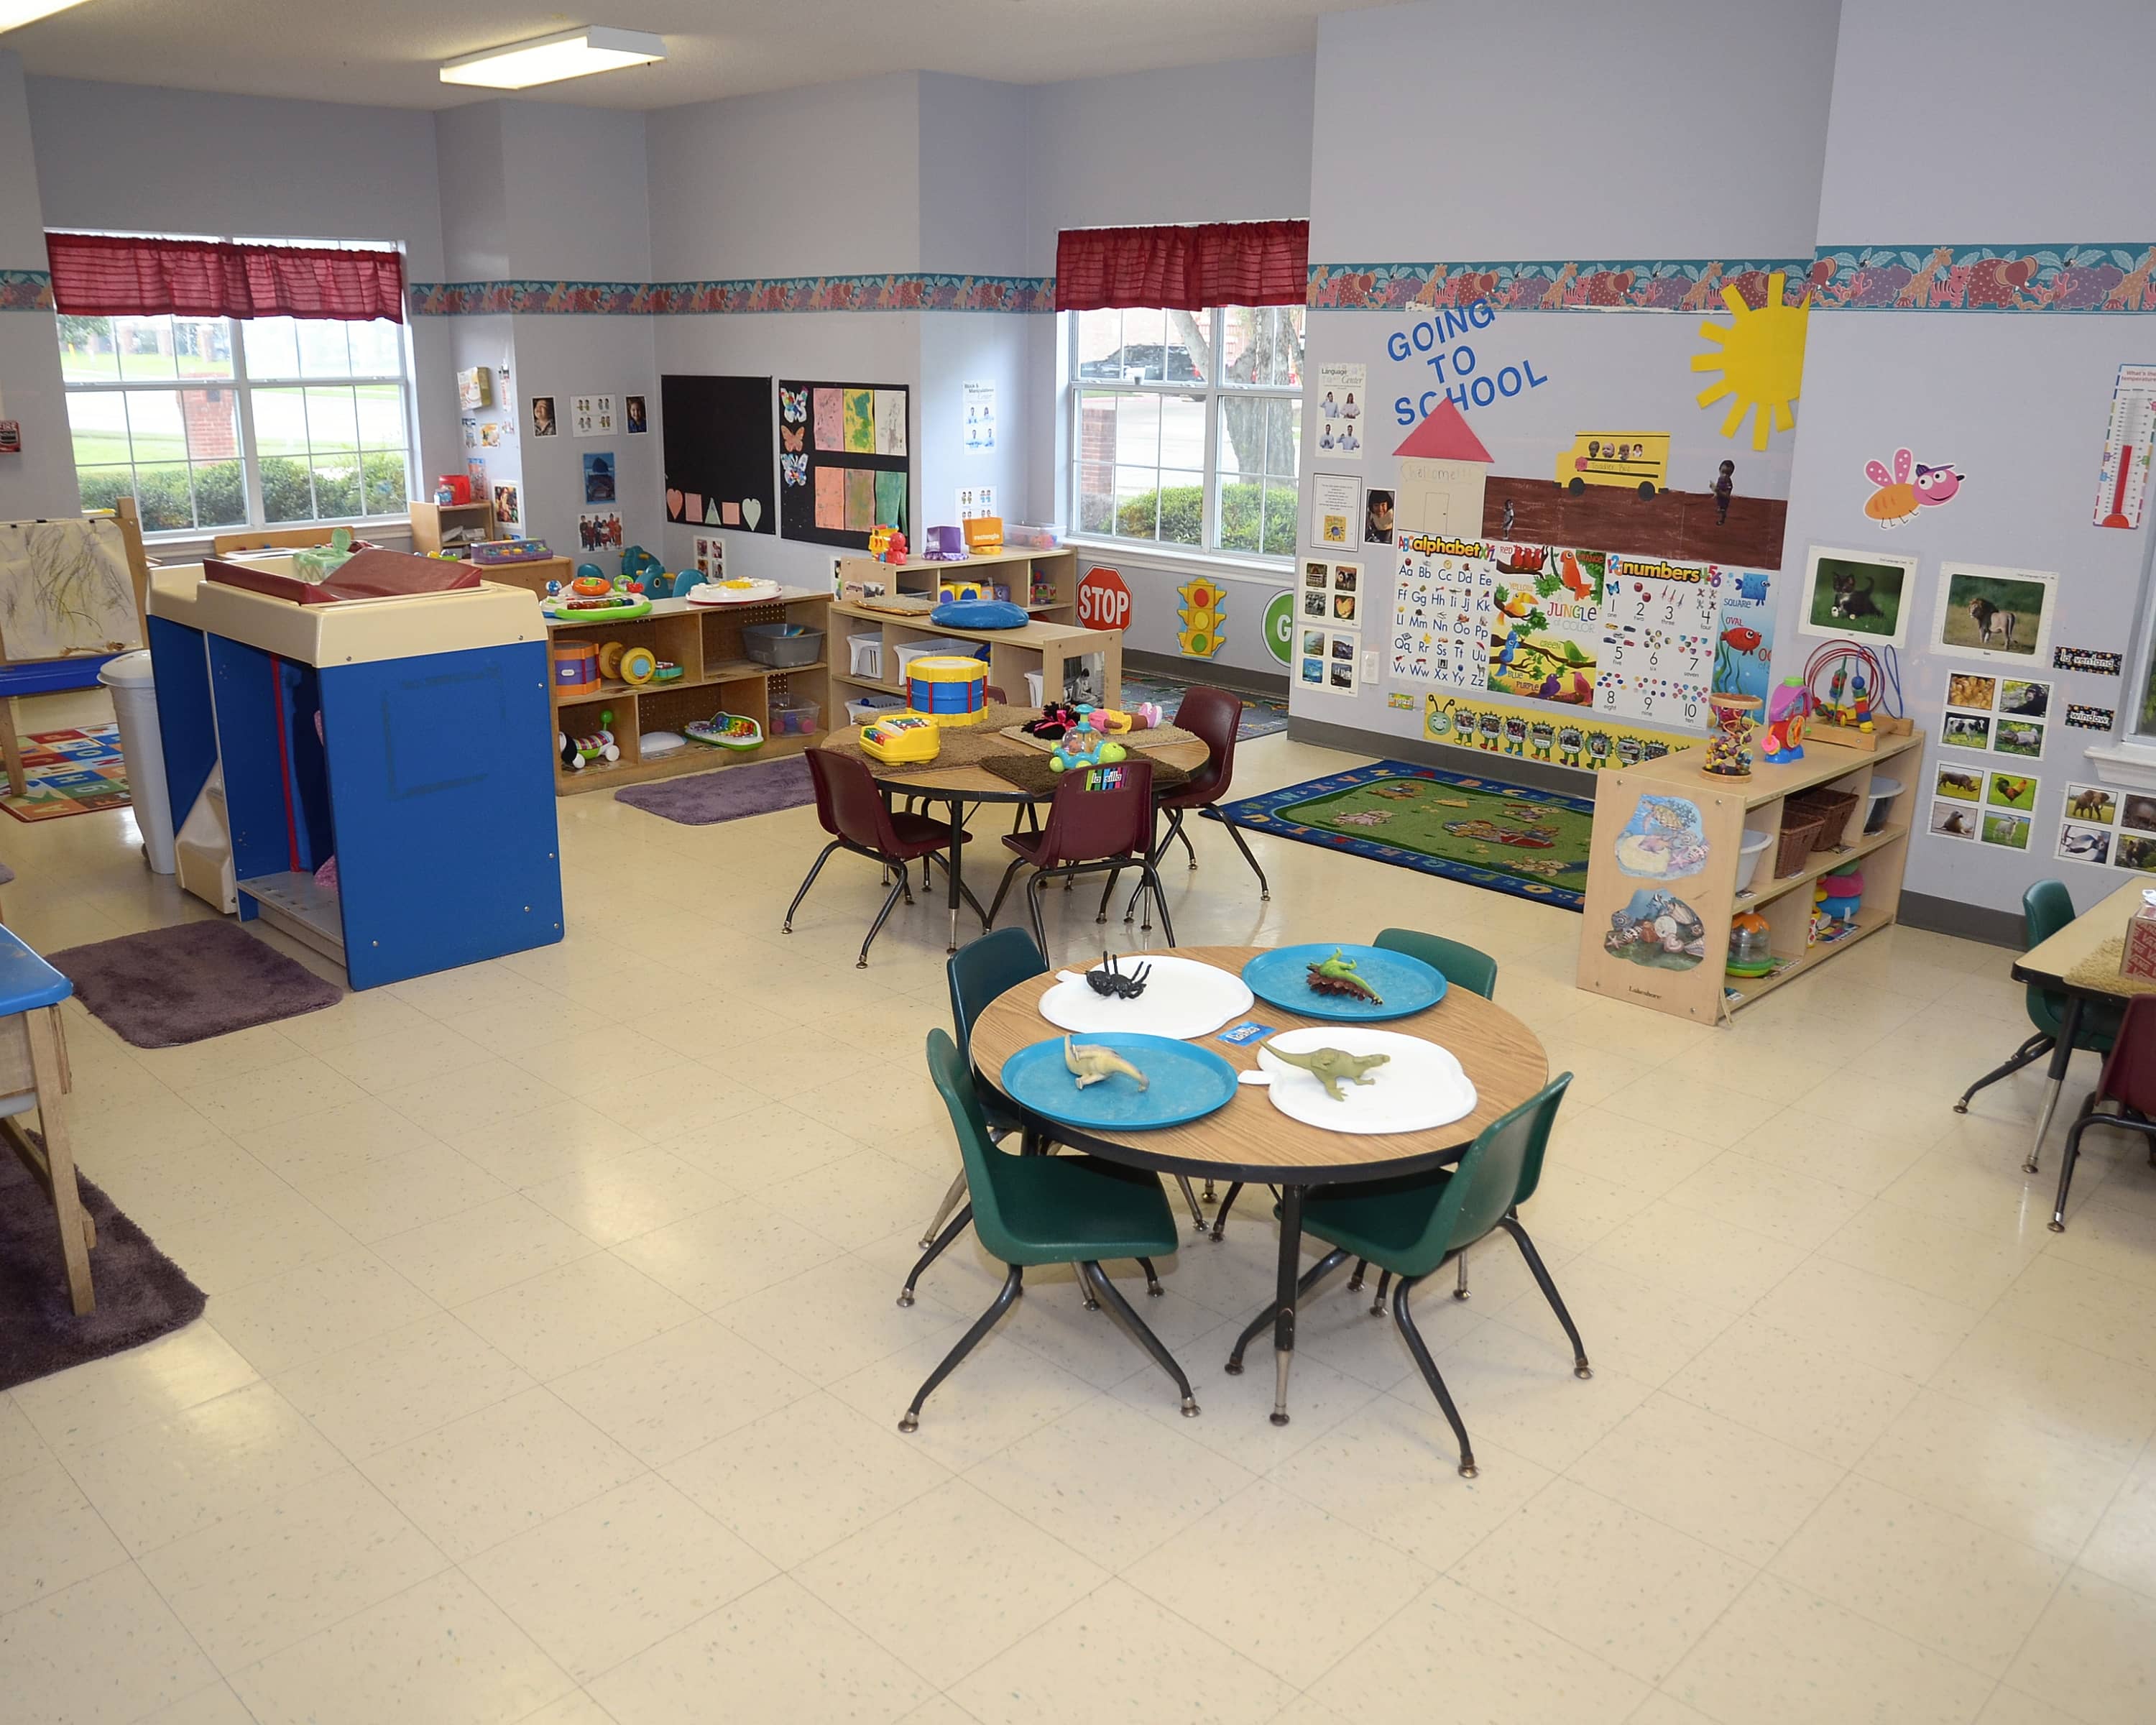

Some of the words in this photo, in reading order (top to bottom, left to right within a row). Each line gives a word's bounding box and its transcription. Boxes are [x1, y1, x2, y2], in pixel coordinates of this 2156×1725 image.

[1388, 298, 1496, 362] GOING
[1427, 346, 1475, 384] TO
[1395, 360, 1548, 426] SCHOOL
[1413, 535, 1480, 557] alphabet
[1399, 565, 1413, 576] Aa
[1419, 566, 1431, 579] Bb
[1438, 569, 1452, 581] Cc
[1458, 571, 1472, 584] Dd
[1479, 574, 1492, 586] Ee
[1623, 561, 1700, 583] numbers
[1079, 584, 1129, 625] STOP
[1398, 589, 1407, 600] Ff
[1411, 592, 1427, 606] Gg
[1432, 594, 1445, 605] Hh
[1450, 596, 1457, 607] Ii
[1461, 598, 1470, 612] Jj
[1477, 599, 1490, 612] Kk
[1636, 602, 1645, 616] 2
[1665, 606, 1674, 620] 3
[1701, 610, 1710, 625] 4
[1726, 617, 1744, 626] OVAL
[1396, 614, 1404, 625] Ll
[1409, 617, 1427, 628] Mm
[1433, 620, 1447, 632] Nn
[1453, 622, 1470, 635] Oo
[1475, 625, 1488, 640] Pp
[1394, 638, 1411, 653] Qq
[1419, 641, 1429, 653] Rr
[1437, 644, 1447, 656] Ss
[1455, 647, 1462, 658] Tt
[1473, 650, 1486, 662] Uu
[1614, 646, 1623, 660] 5
[1649, 652, 1658, 665] 6
[1690, 657, 1699, 671] 7
[2060, 650, 2070, 661] la
[2075, 655, 2114, 667] ventana
[1393, 661, 1405, 673] Vv
[1409, 664, 1429, 677] Ww
[1434, 668, 1448, 681] Xx
[1452, 671, 1465, 686] Yy
[1470, 674, 1484, 686] Zz
[1607, 691, 1615, 704] 8
[1644, 697, 1652, 710] 9
[1685, 703, 1697, 717] 10
[2070, 712, 2109, 724] window
[1092, 773, 1101, 783] la
[1105, 771, 1122, 782] silla
